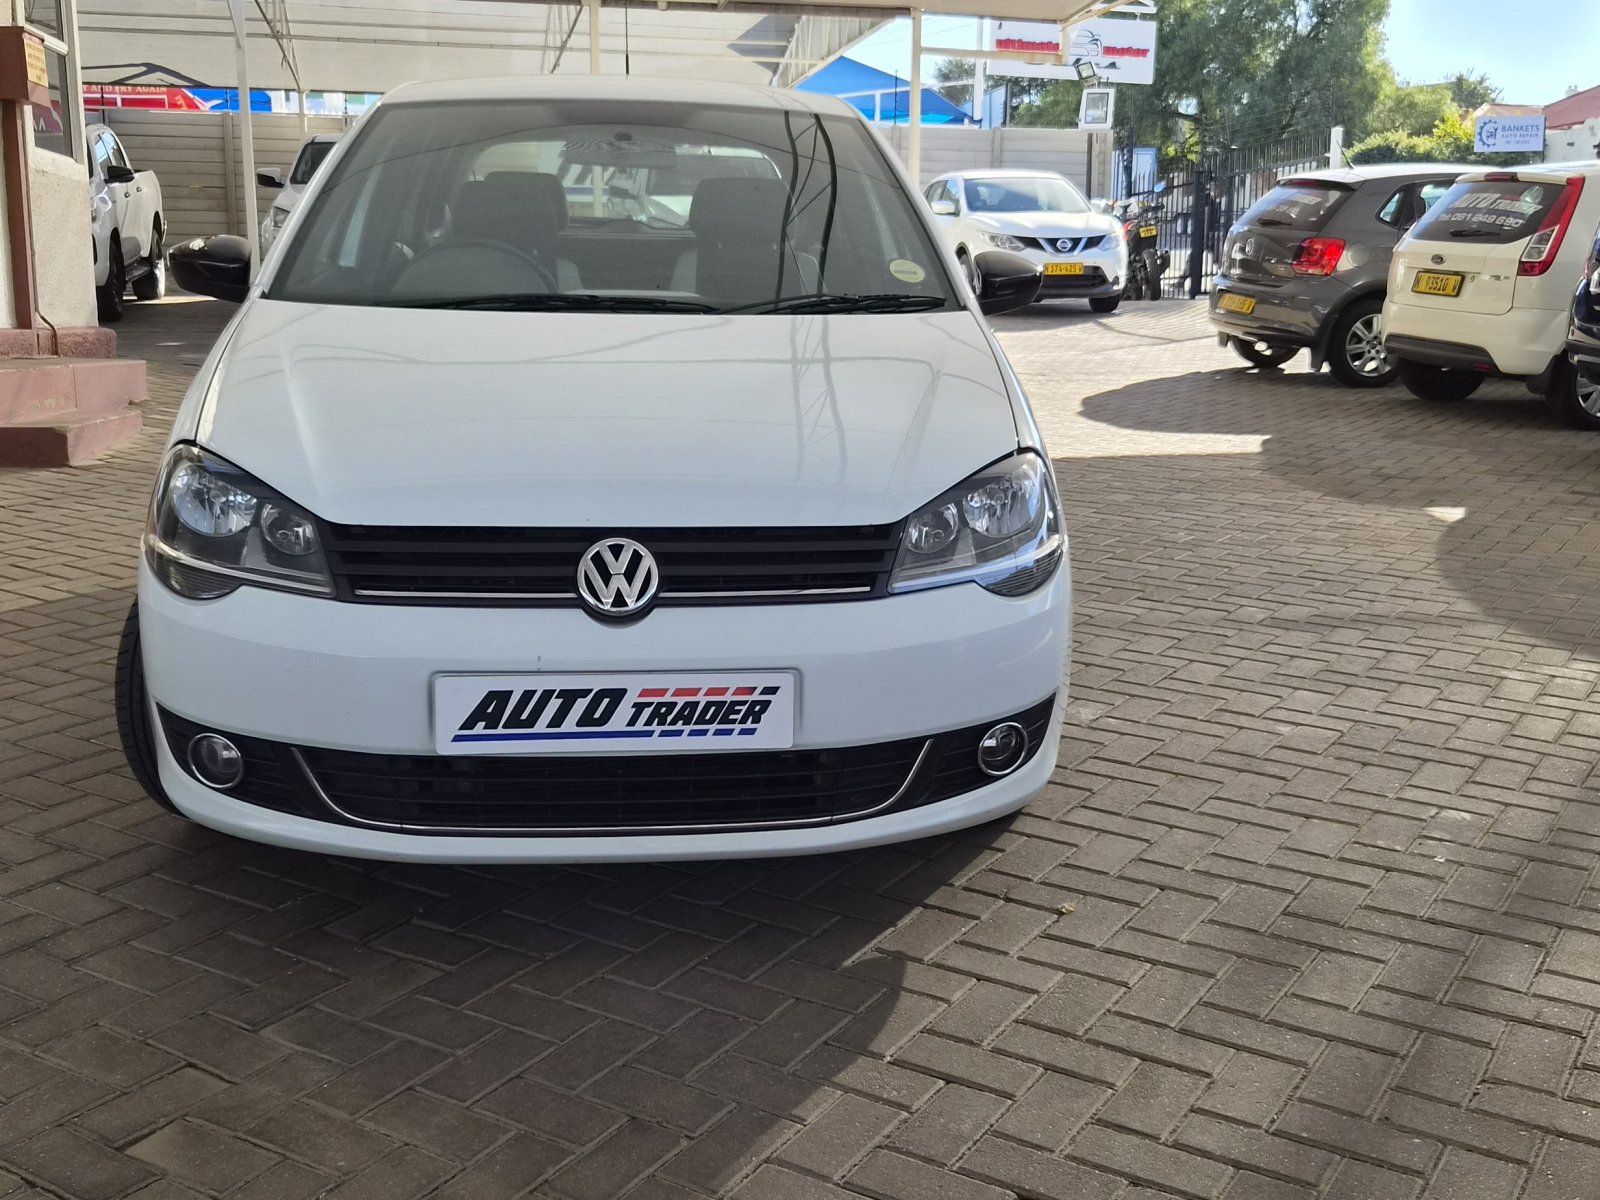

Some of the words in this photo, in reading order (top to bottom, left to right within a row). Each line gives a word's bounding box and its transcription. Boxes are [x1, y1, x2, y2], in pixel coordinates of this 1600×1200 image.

[1501, 124, 1540, 132] BANKETS
[457, 688, 628, 731] AUTO
[625, 699, 773, 728] TRADER
